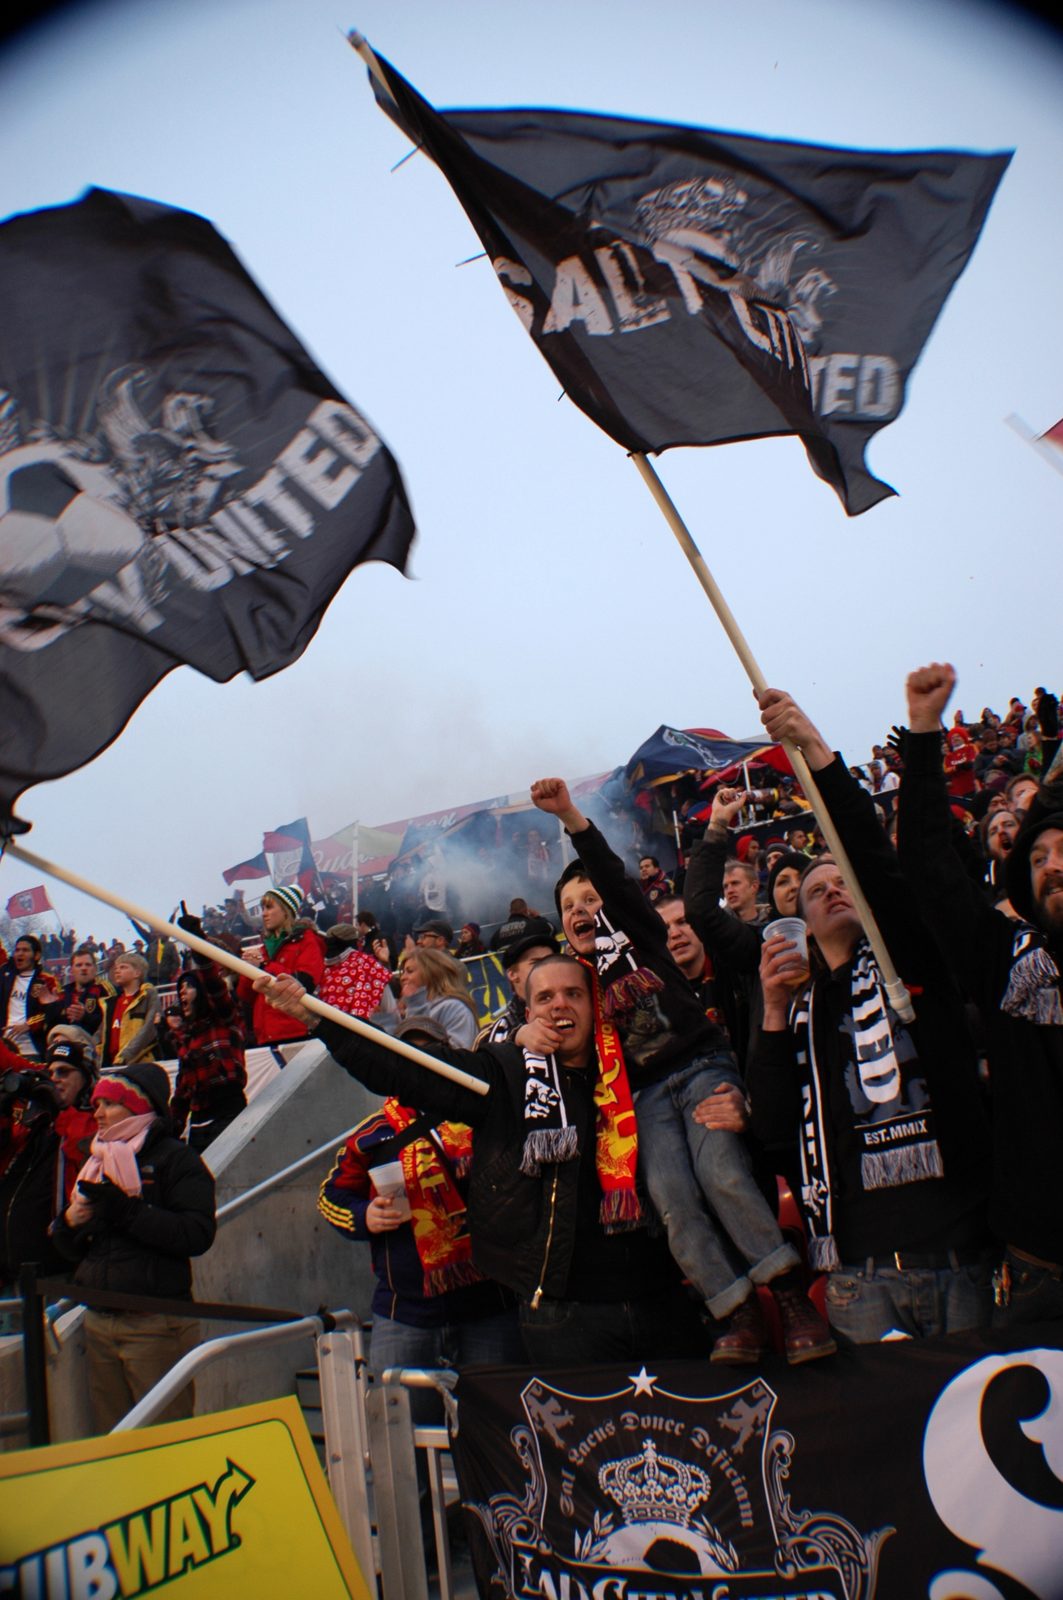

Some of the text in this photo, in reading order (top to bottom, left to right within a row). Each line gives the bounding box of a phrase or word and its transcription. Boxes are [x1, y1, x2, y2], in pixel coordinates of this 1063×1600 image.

[152, 398, 383, 593] UNITED
[601, 1023, 617, 1057] TWO
[620, 1411, 685, 1436] Donec
[0, 1457, 256, 1600] UBWAY
